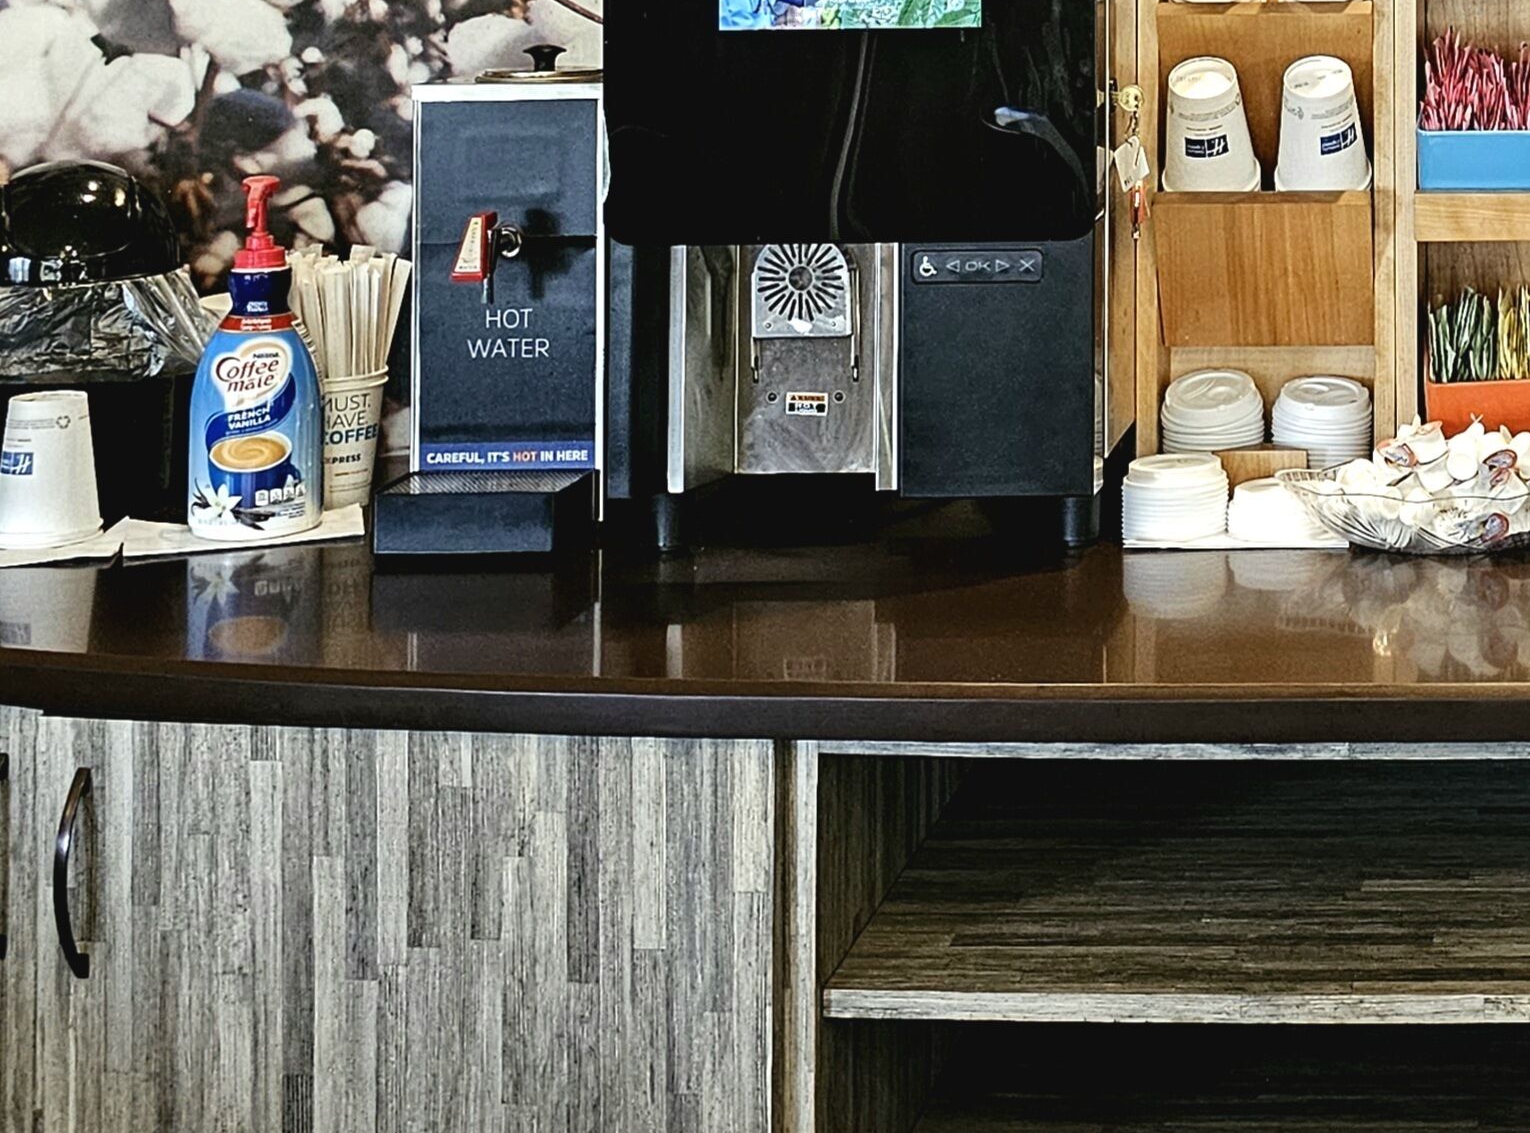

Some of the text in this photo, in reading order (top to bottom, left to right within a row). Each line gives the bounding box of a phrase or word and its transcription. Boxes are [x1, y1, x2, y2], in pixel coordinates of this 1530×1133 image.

[965, 261, 992, 272] OK
[486, 308, 533, 329] HOT
[467, 338, 550, 358] WATER
[216, 357, 279, 382] Coffee
[227, 374, 275, 392] mate
[228, 405, 271, 422] FRENCH
[228, 414, 271, 430] VANILLA
[426, 450, 588, 465] CAREFUL, IT'S HOT IN HERE
